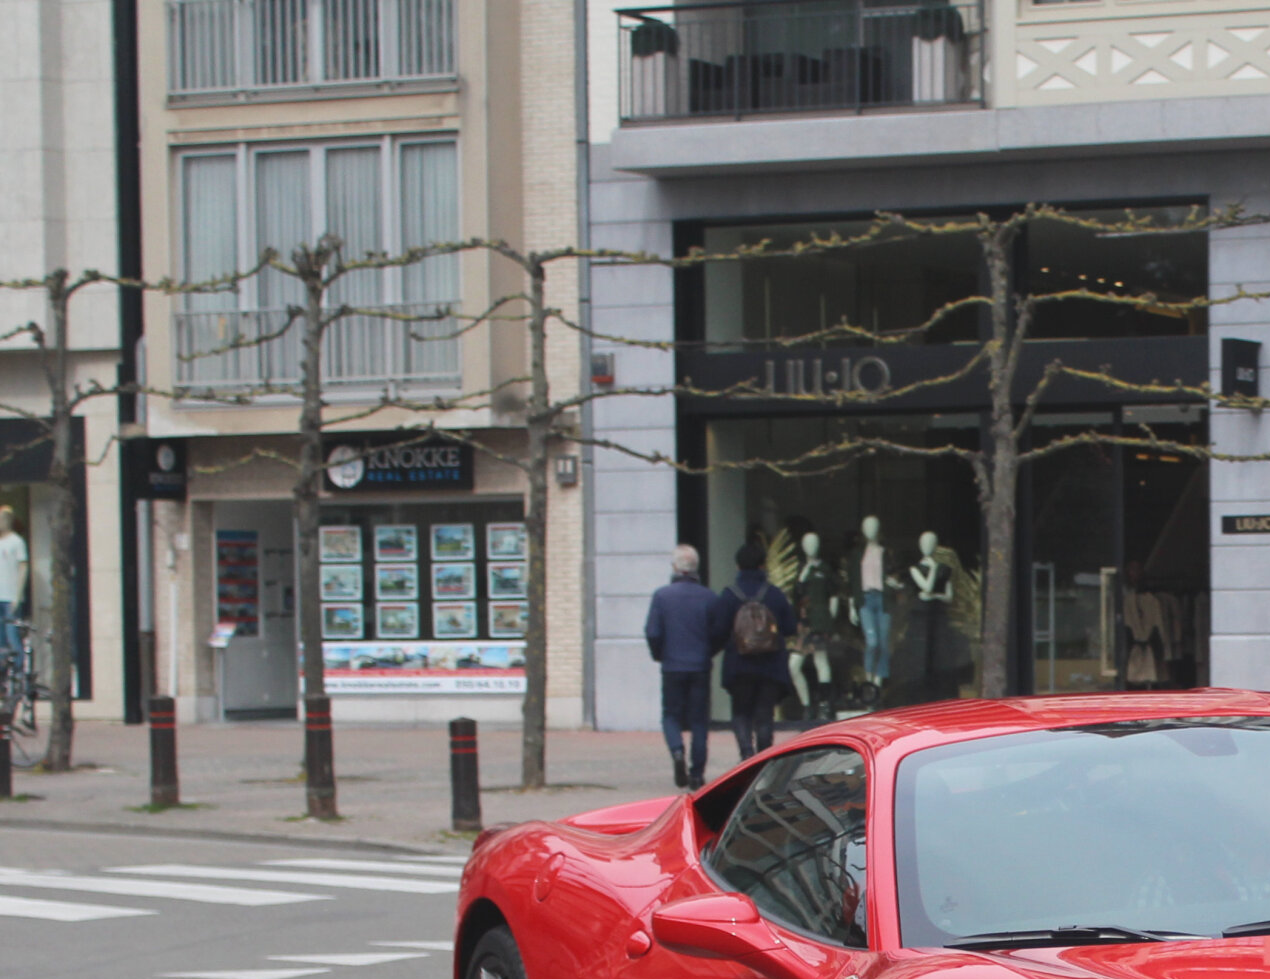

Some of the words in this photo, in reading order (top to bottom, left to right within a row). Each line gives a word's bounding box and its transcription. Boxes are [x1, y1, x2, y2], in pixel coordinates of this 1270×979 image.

[368, 448, 460, 469] KNOKKE
[367, 470, 402, 481] REAL
[409, 470, 460, 480] ESTATE
